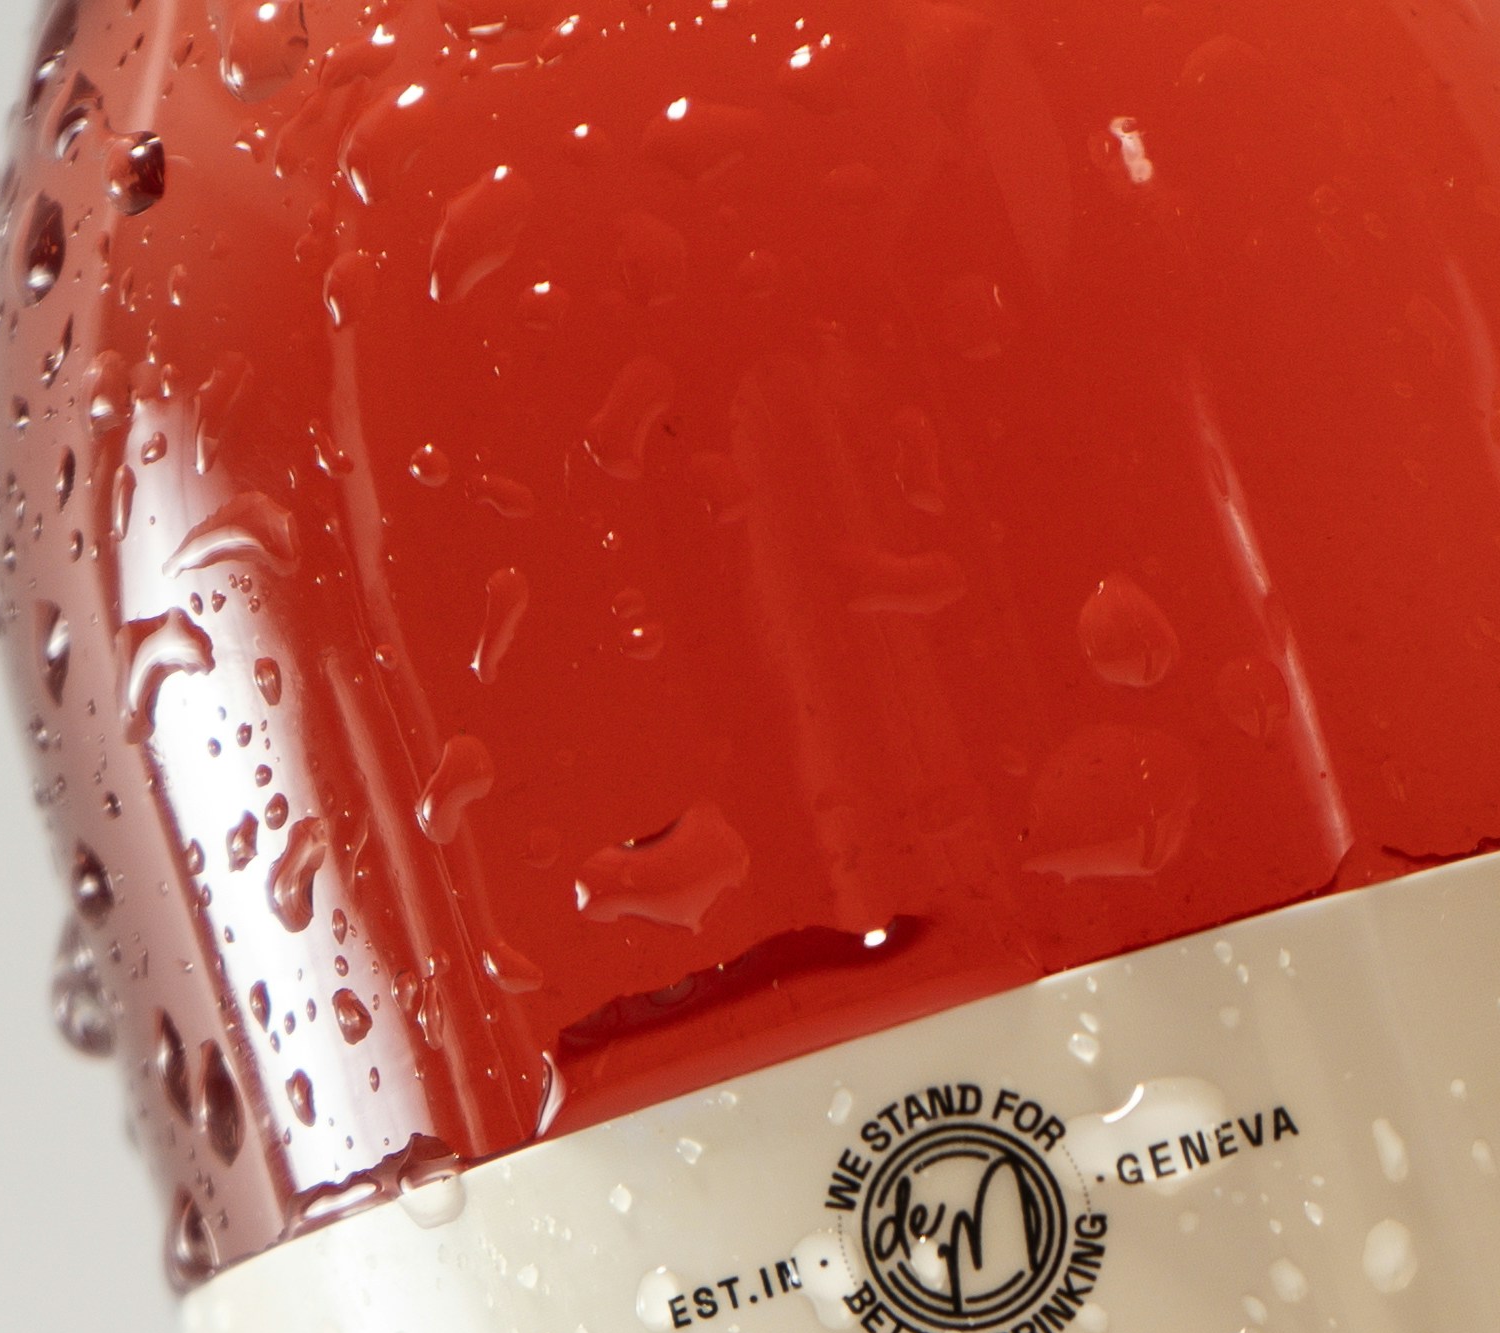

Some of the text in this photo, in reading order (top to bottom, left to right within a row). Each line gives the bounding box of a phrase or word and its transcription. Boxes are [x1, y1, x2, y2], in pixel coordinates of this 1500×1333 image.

[824, 1083, 1067, 1212] WE STAND FOR
[1116, 1104, 1300, 1186] GENEVA
